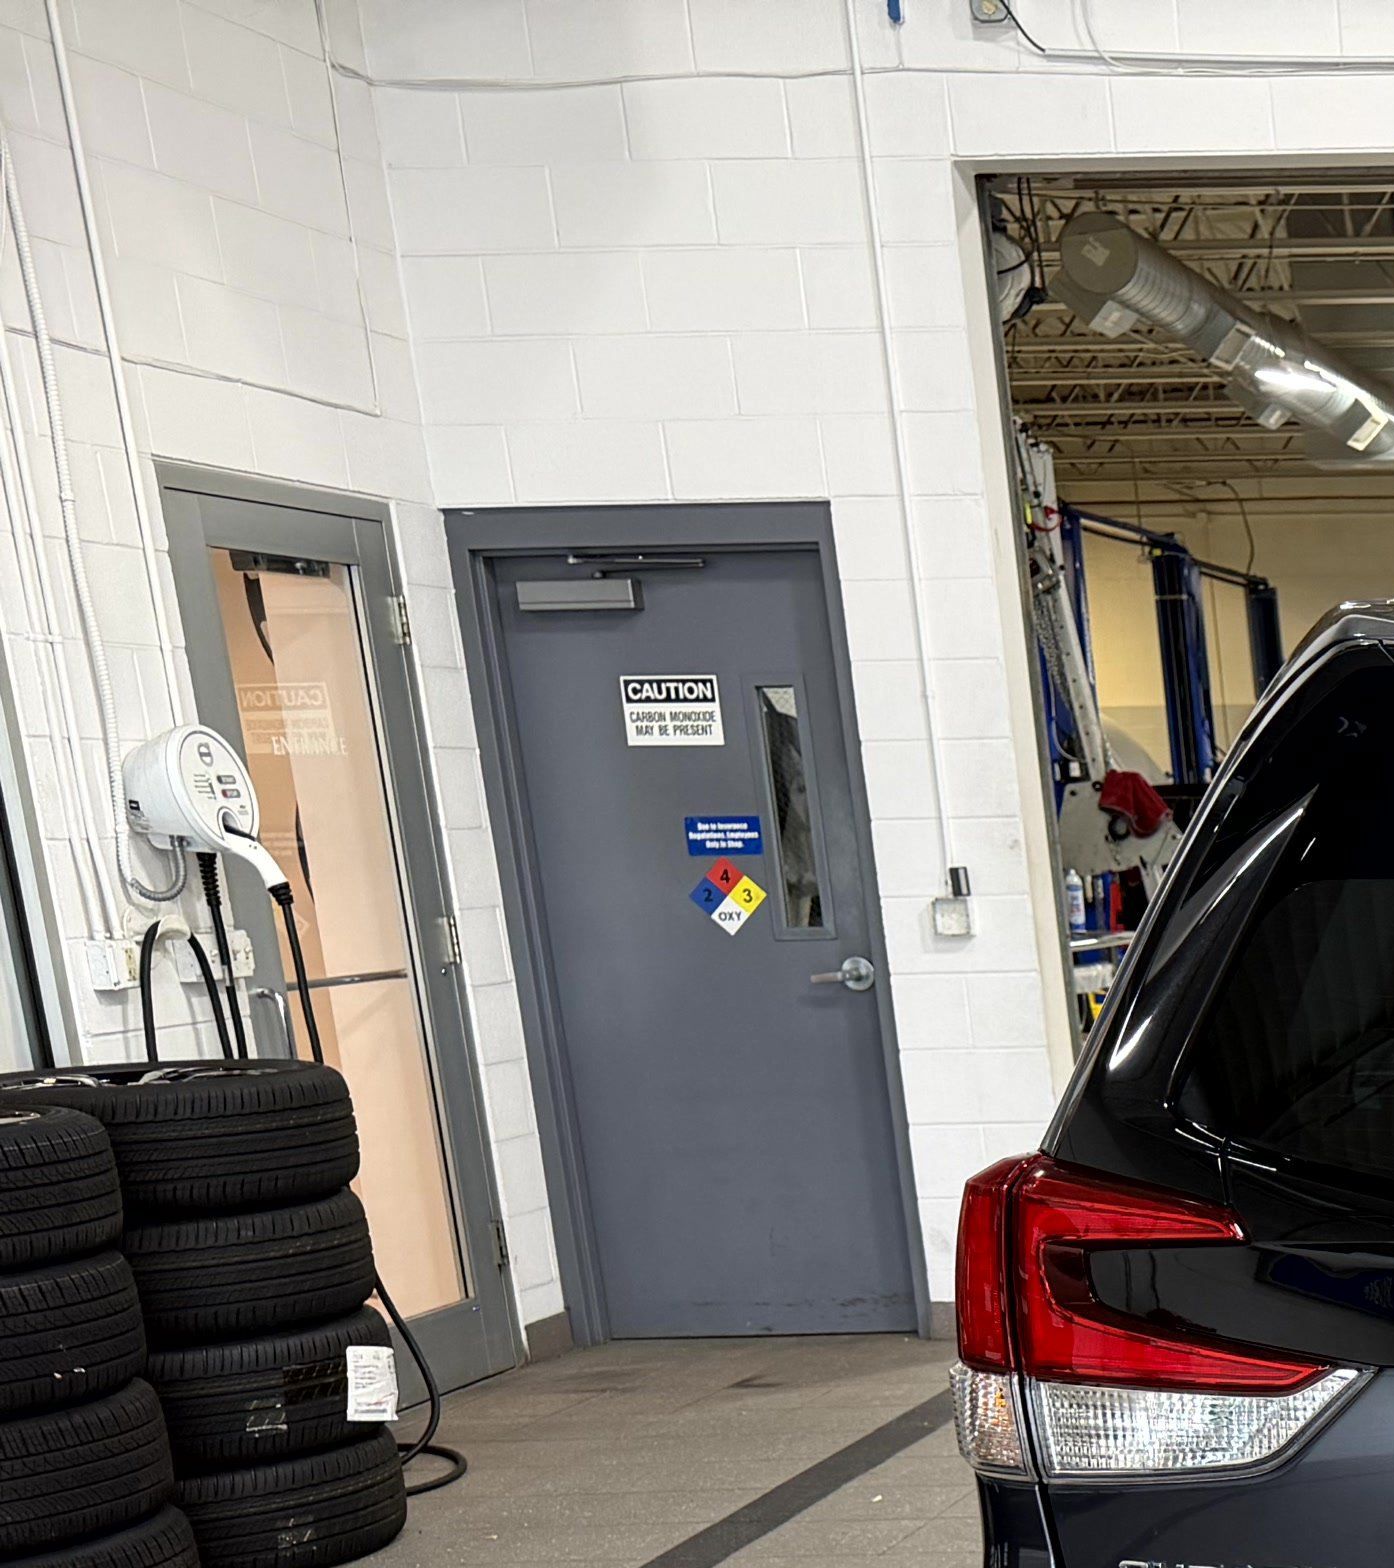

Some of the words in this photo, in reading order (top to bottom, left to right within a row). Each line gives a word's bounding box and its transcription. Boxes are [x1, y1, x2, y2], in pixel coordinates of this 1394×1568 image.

[627, 682, 712, 700] CAUTION
[629, 711, 666, 723] CARBON
[670, 710, 716, 723] MONOXIDE
[635, 725, 654, 736] MAY
[658, 725, 670, 736] BE
[673, 725, 712, 736] PRESENT
[720, 868, 731, 885] 4
[702, 888, 713, 903] 2
[742, 888, 753, 904] 3
[718, 911, 742, 922] OXY
